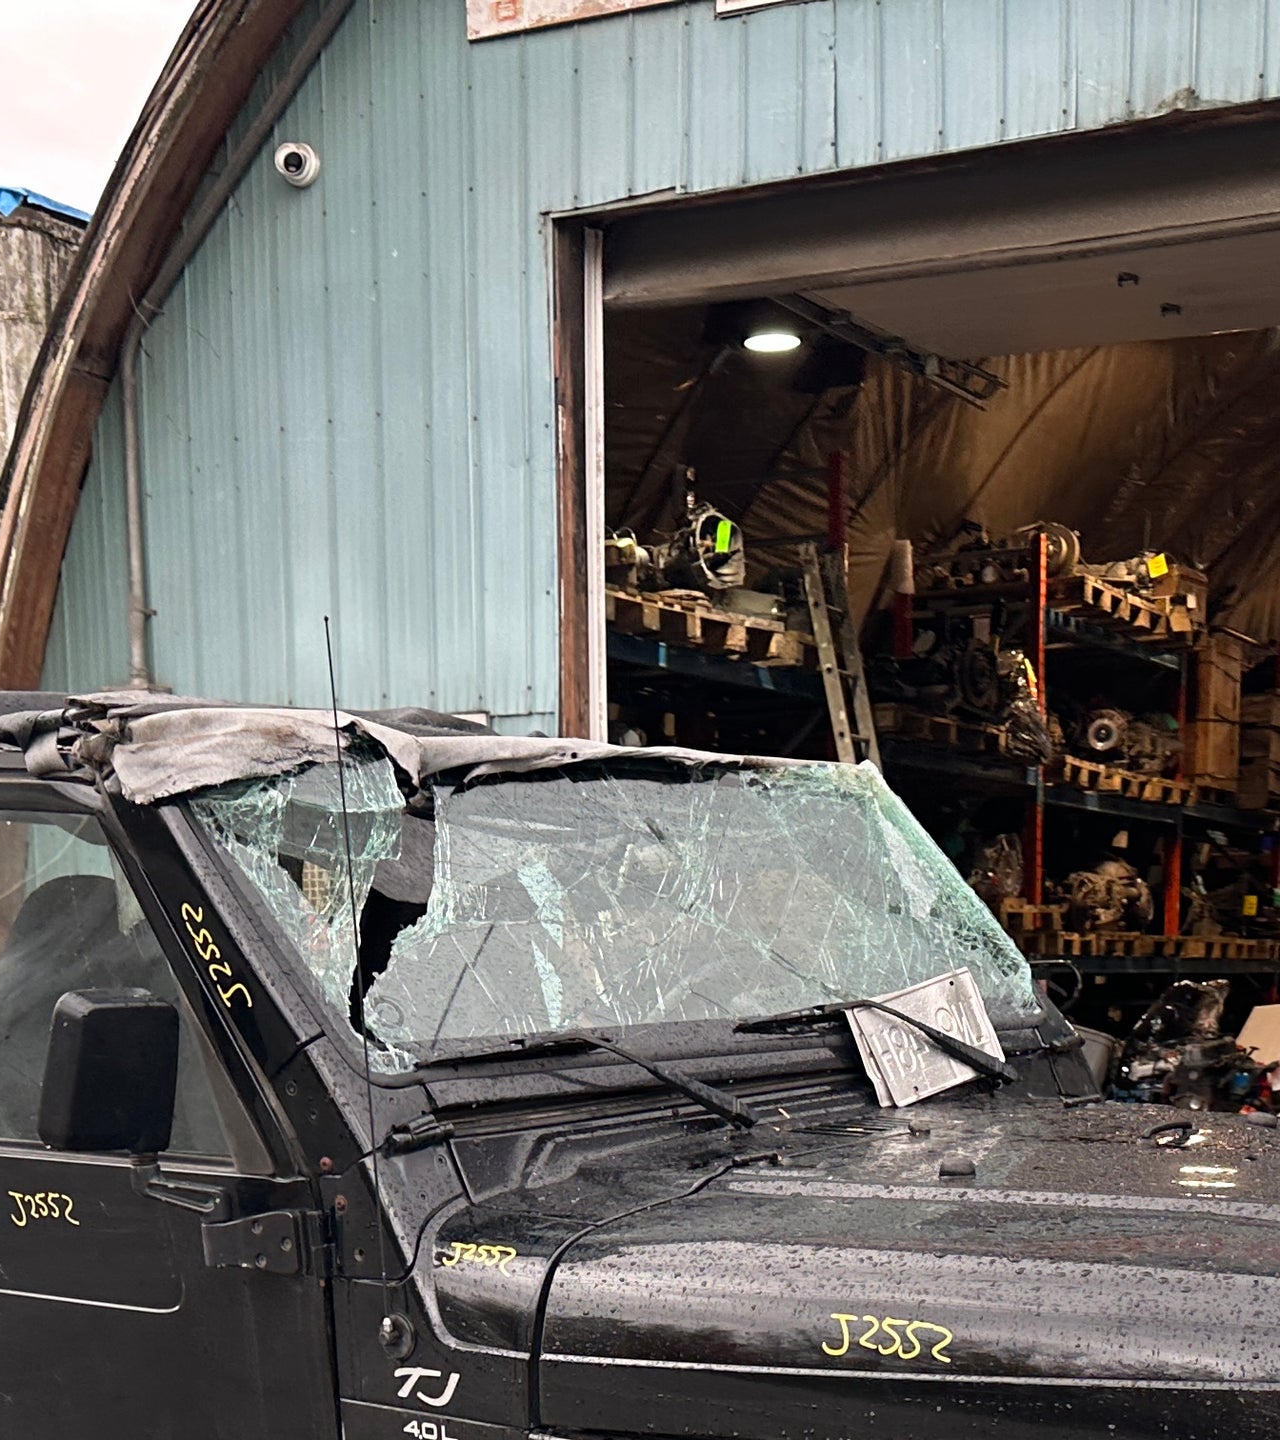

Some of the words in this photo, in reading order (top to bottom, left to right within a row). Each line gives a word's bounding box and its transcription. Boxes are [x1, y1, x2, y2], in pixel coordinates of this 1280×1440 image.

[181, 902, 253, 1008] J2552
[7, 1190, 80, 1227] J2552
[442, 1242, 517, 1277] J2552
[821, 1312, 954, 1364] J2552
[393, 1366, 461, 1407] TJ
